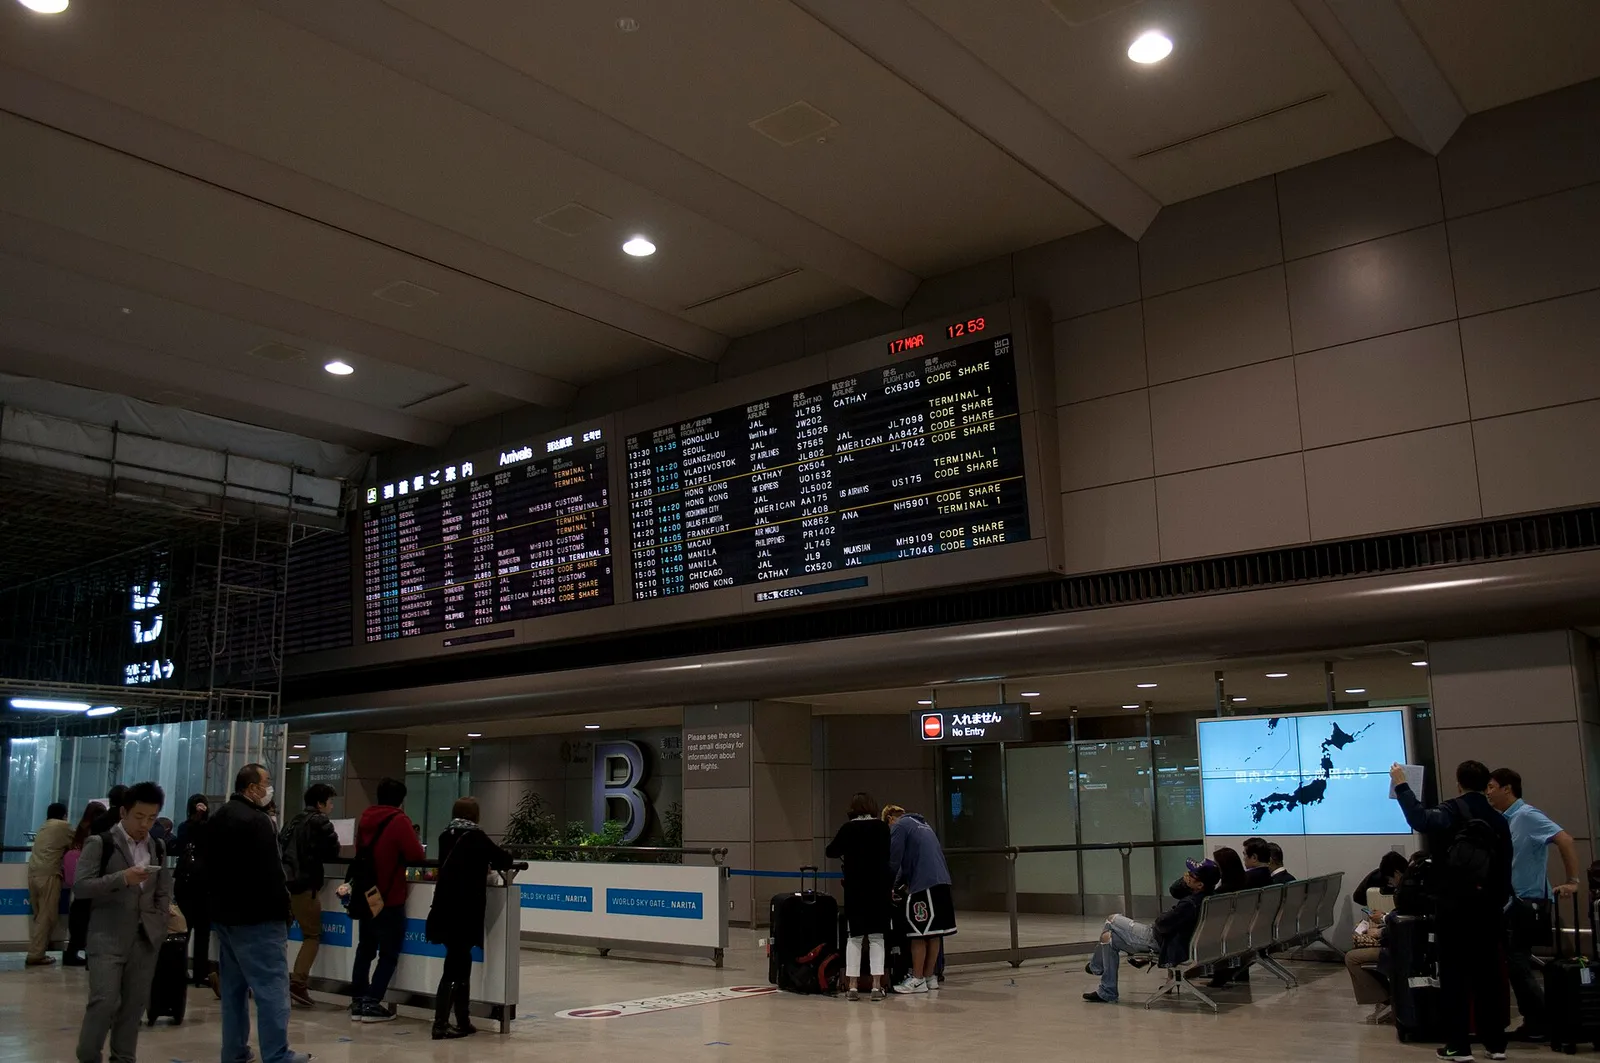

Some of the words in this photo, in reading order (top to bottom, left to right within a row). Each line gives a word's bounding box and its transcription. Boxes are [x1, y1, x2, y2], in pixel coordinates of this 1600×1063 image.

[994, 346, 1010, 356] EXIT
[925, 360, 957, 374] REMARKS
[832, 387, 855, 397] AIRLINE
[629, 449, 650, 459] 13:30
[682, 431, 719, 445] HONOLULU
[749, 420, 763, 429] JAL
[795, 404, 821, 417] JL785
[834, 393, 867, 407] CATHAY
[885, 379, 920, 394] CX6305
[926, 371, 951, 384] CODE
[958, 361, 990, 376] SHARE
[748, 409, 767, 420] AIRLINE
[630, 468, 651, 479] 13:50
[683, 451, 725, 466] GUANGZHOU
[750, 441, 765, 450] JAL
[797, 425, 828, 439] JL5026
[929, 390, 978, 406] TERMINAL
[630, 458, 650, 469] 13:40
[683, 446, 705, 456] SEOUL
[796, 416, 822, 428] JW202
[630, 478, 652, 488] 13:55
[684, 459, 736, 476] VLADIVOSTOK
[797, 438, 823, 450] S7565
[836, 431, 852, 441] JAL
[888, 414, 923, 429] JL7098
[929, 406, 954, 419] CODE
[962, 398, 993, 412] SHARE
[500, 446, 533, 466] Arrivals
[631, 488, 652, 498] 14:00
[684, 475, 711, 486] TAIPEI
[752, 463, 766, 471] JAL
[798, 449, 824, 461] JL802
[837, 436, 882, 452] AMERICAN
[889, 426, 924, 440] AA8424
[930, 419, 955, 431] CODE
[962, 410, 994, 424] SHARE
[632, 498, 652, 508] 14:05
[685, 487, 704, 497] HONG
[708, 482, 728, 492] KONG
[752, 470, 782, 482] CATHAY
[798, 460, 825, 472] CX504
[838, 454, 854, 463] JAL
[890, 438, 924, 452] JL7042
[931, 431, 956, 443] CODE
[963, 422, 995, 436] SHARE
[554, 467, 584, 478] TERMINAL
[632, 519, 654, 528] 14:10
[754, 495, 768, 504] JAL
[800, 481, 832, 494] JL5002
[934, 451, 984, 466] TERMINAL
[555, 495, 582, 507] CUSTOMS
[632, 508, 653, 518] 14:05
[685, 497, 704, 507] HONG
[709, 492, 728, 502] KONG
[633, 529, 654, 538] 14:20
[754, 500, 795, 514] AMERICAN
[801, 493, 827, 505] AA175
[892, 474, 922, 487] US175
[934, 467, 959, 478] CODE
[967, 459, 998, 472] SHARE
[556, 514, 586, 525] TERMINAL
[633, 539, 655, 548] 14:40
[687, 524, 729, 537] FRANKFURT
[755, 517, 770, 525] JAL
[802, 505, 828, 516] JL408
[634, 549, 655, 558] 15:00
[687, 538, 711, 548] MACAU
[802, 516, 828, 527] NX862
[842, 511, 858, 520] ANA
[894, 498, 928, 510] NH5901
[936, 491, 961, 502] CODE
[968, 484, 1000, 497] SHARE
[556, 533, 584, 544] CUSTOMS
[634, 559, 656, 568] 15:00
[688, 548, 716, 559] MANILA
[803, 526, 835, 538] PR1402
[938, 500, 988, 514] TERMINAL
[569, 550, 601, 561] TERMINAL
[635, 579, 656, 588] 15:10
[689, 568, 723, 580] CHICAGO
[758, 560, 772, 569] JAL
[805, 552, 820, 561] JL9
[896, 533, 933, 546] MH9109
[939, 527, 964, 538] CODE
[972, 521, 1004, 533] SHARE
[635, 569, 656, 578] 15:05
[688, 559, 717, 569] MANILA
[757, 550, 772, 558] JAL
[804, 539, 830, 550] JL746
[557, 564, 573, 573] CODE
[577, 560, 597, 569] SHARE
[636, 589, 657, 599] 15:15
[690, 581, 709, 590] HONG
[714, 577, 733, 586] KONG
[758, 569, 788, 580] CATHAY
[805, 561, 832, 572] CX520
[846, 557, 862, 566] JAL
[898, 545, 934, 558] JL7046
[940, 540, 965, 551] CODE
[973, 533, 1005, 546] SHARE
[558, 572, 586, 582] CUSTOMS
[558, 583, 574, 592] CODE
[578, 579, 598, 589] SHARE
[559, 593, 575, 601] CODE
[578, 589, 598, 598] SHARE
[952, 712, 1001, 725] 入れません
[952, 728, 963, 737] No
[965, 727, 985, 737] Entry
[715, 742, 735, 750] display
[592, 740, 646, 844] B
[612, 897, 635, 906] WORLD
[404, 932, 419, 941] SKY
